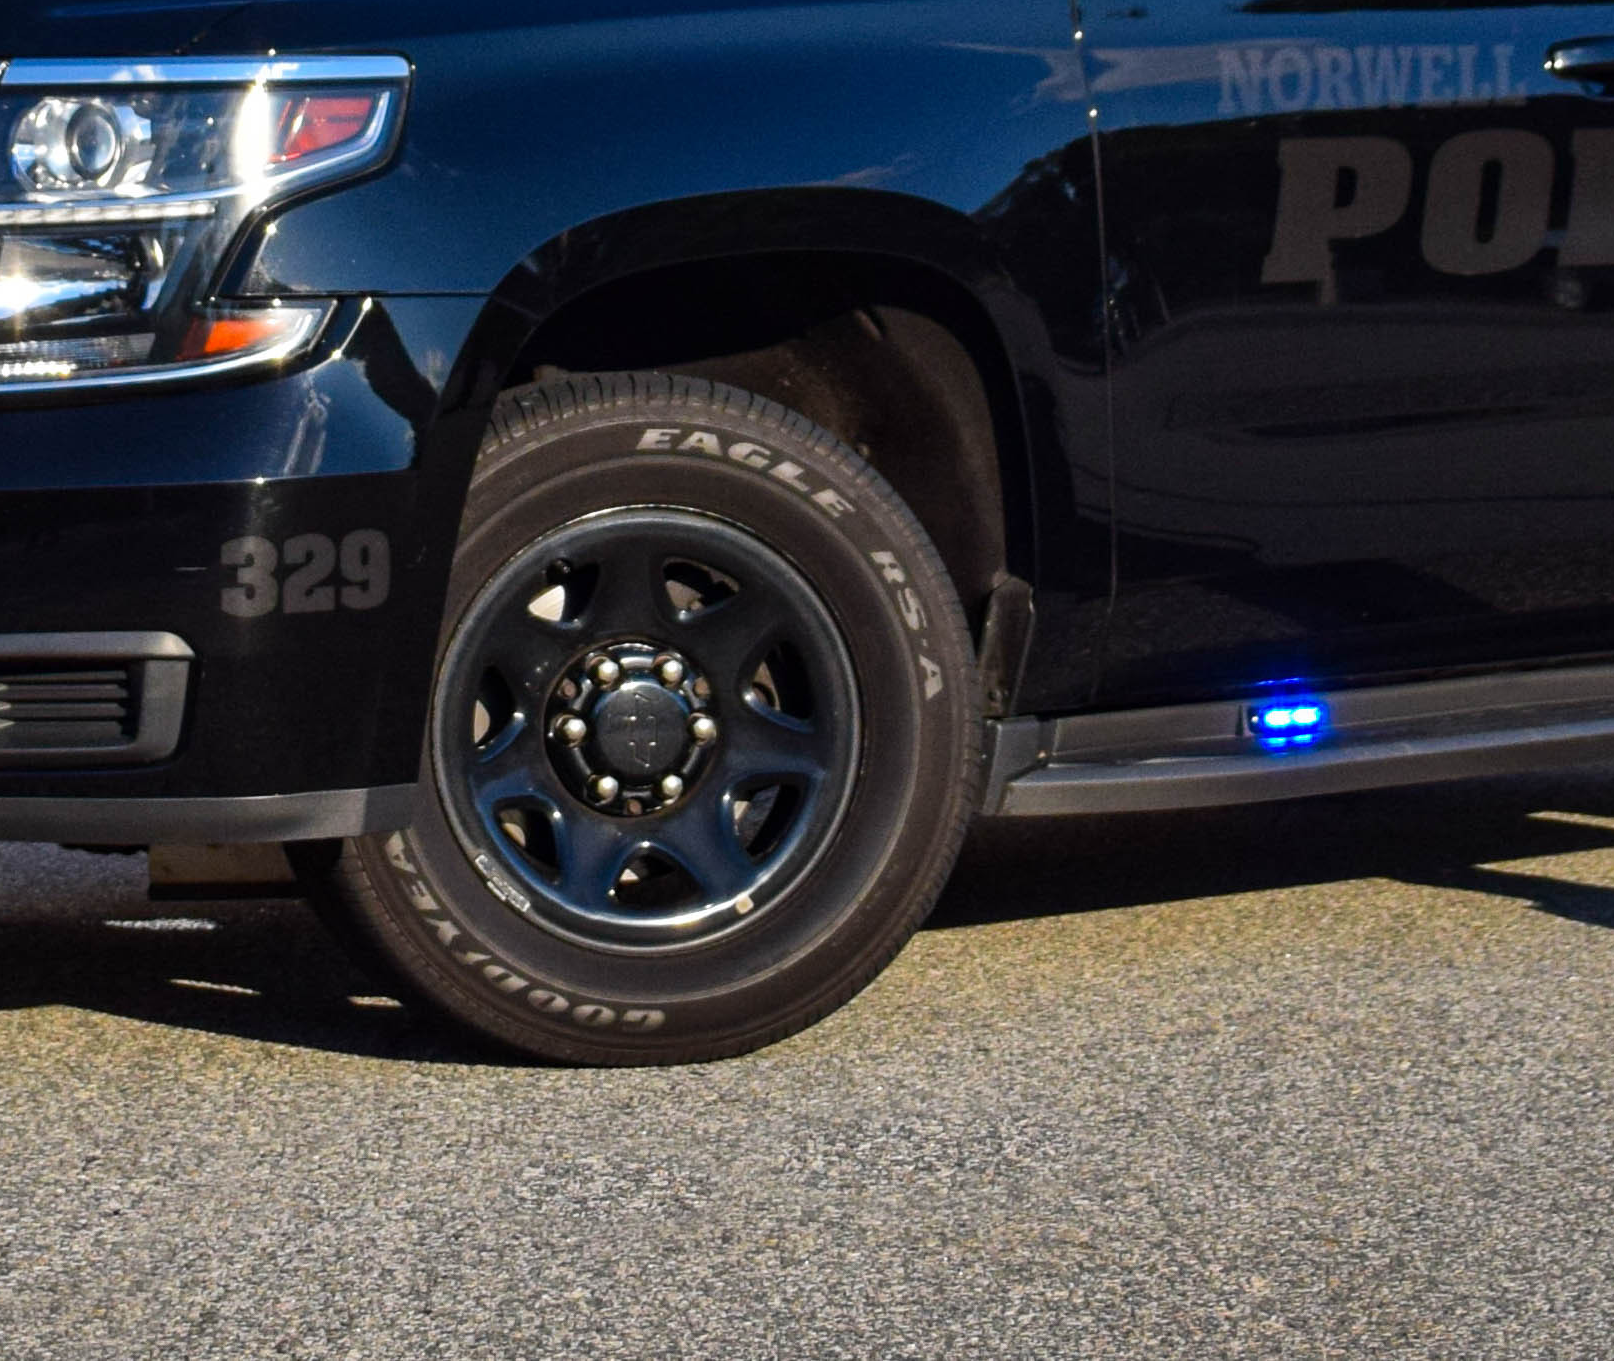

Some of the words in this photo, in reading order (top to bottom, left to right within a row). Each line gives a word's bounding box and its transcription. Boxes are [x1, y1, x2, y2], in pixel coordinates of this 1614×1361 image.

[1216, 44, 1529, 115] NORWELL
[636, 428, 857, 519] EAGLE
[220, 528, 391, 618] 329
[386, 830, 667, 1033] GOODYEA
